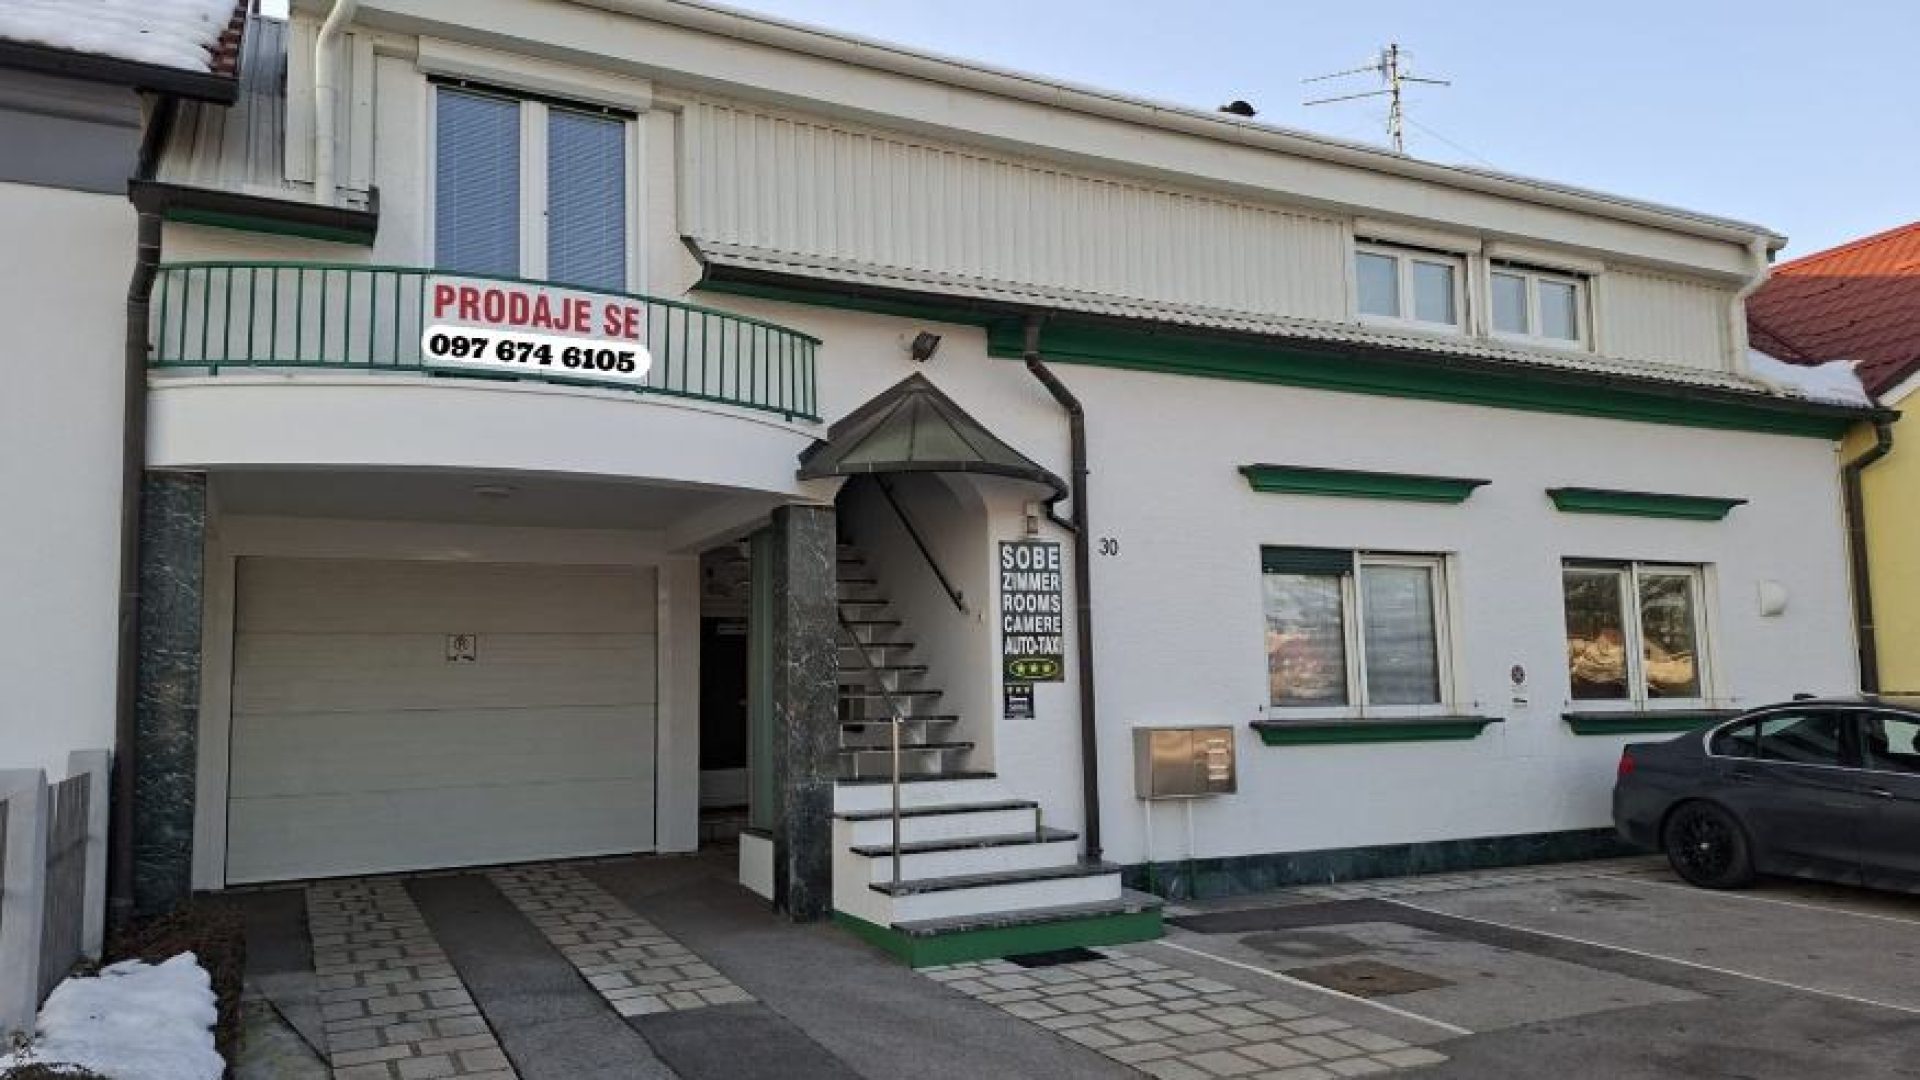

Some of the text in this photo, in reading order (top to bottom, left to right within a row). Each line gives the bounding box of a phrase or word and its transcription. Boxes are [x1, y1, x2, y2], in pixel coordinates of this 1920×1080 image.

[434, 284, 640, 339] PRODAJE SE
[1098, 537, 1119, 556] 30
[1002, 544, 1060, 570] SOBE
[1003, 572, 1061, 591] ZIMMER
[1003, 594, 1061, 613] ROOMS
[1004, 616, 1062, 633] CAMERE
